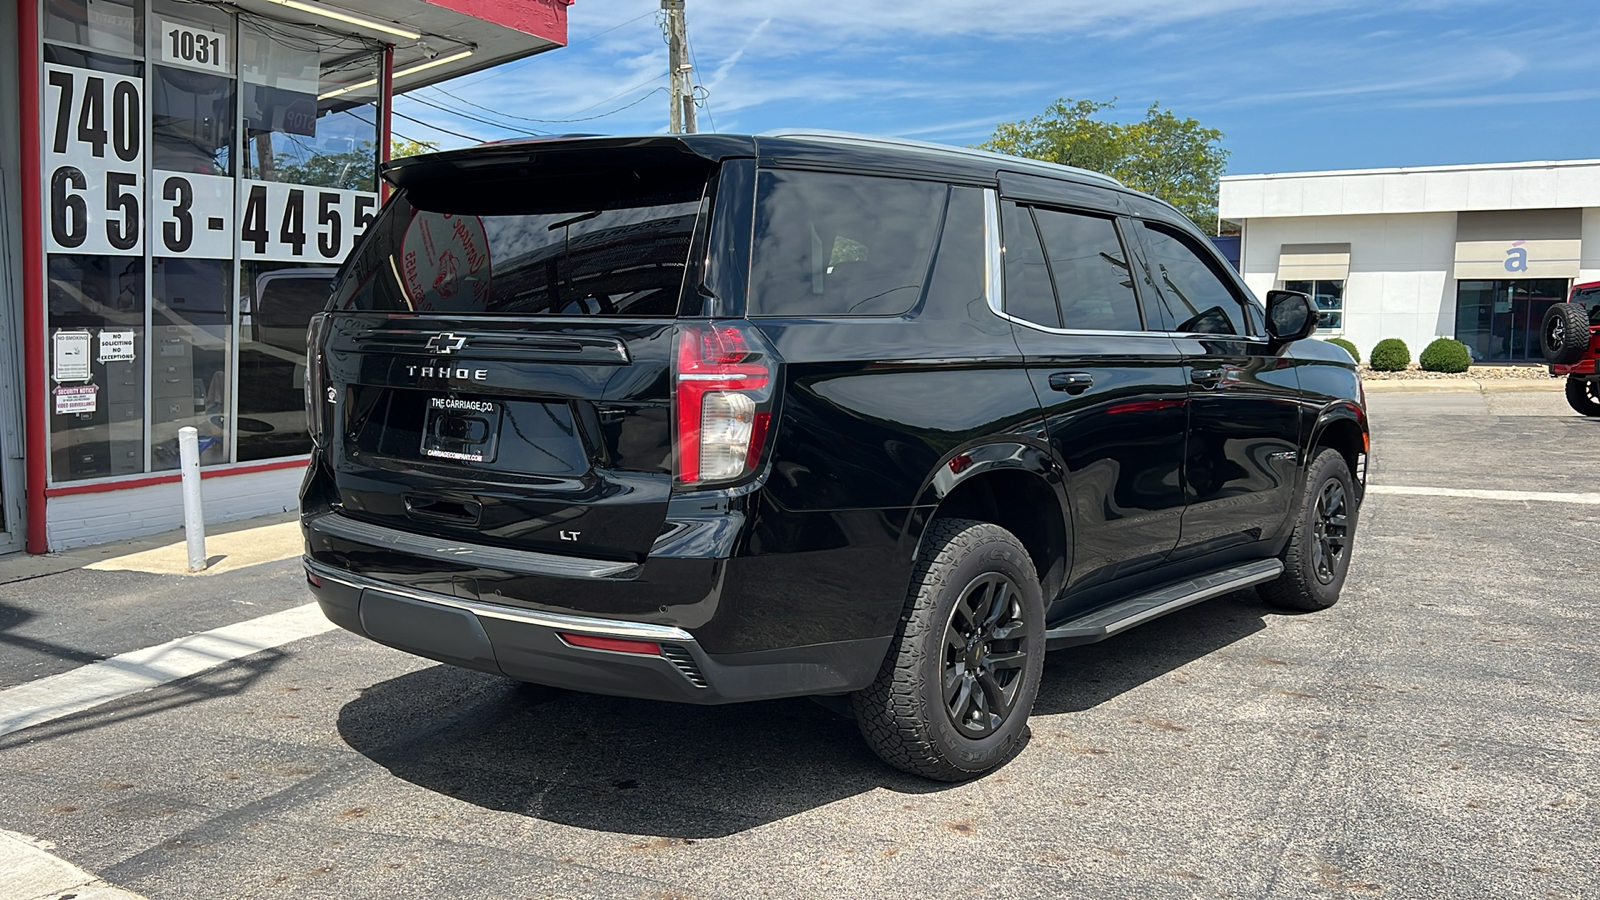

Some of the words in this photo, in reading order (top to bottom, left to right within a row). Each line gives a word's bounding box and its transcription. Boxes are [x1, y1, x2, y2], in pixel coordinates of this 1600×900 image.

[168, 28, 221, 67] 1031
[48, 70, 141, 163] 740
[405, 364, 489, 382] TAHOE
[431, 397, 445, 408] THE
[445, 399, 481, 411] CARRIAGE
[427, 449, 483, 462] CARRIAGECOMPANY.COM
[559, 529, 581, 542] LT
